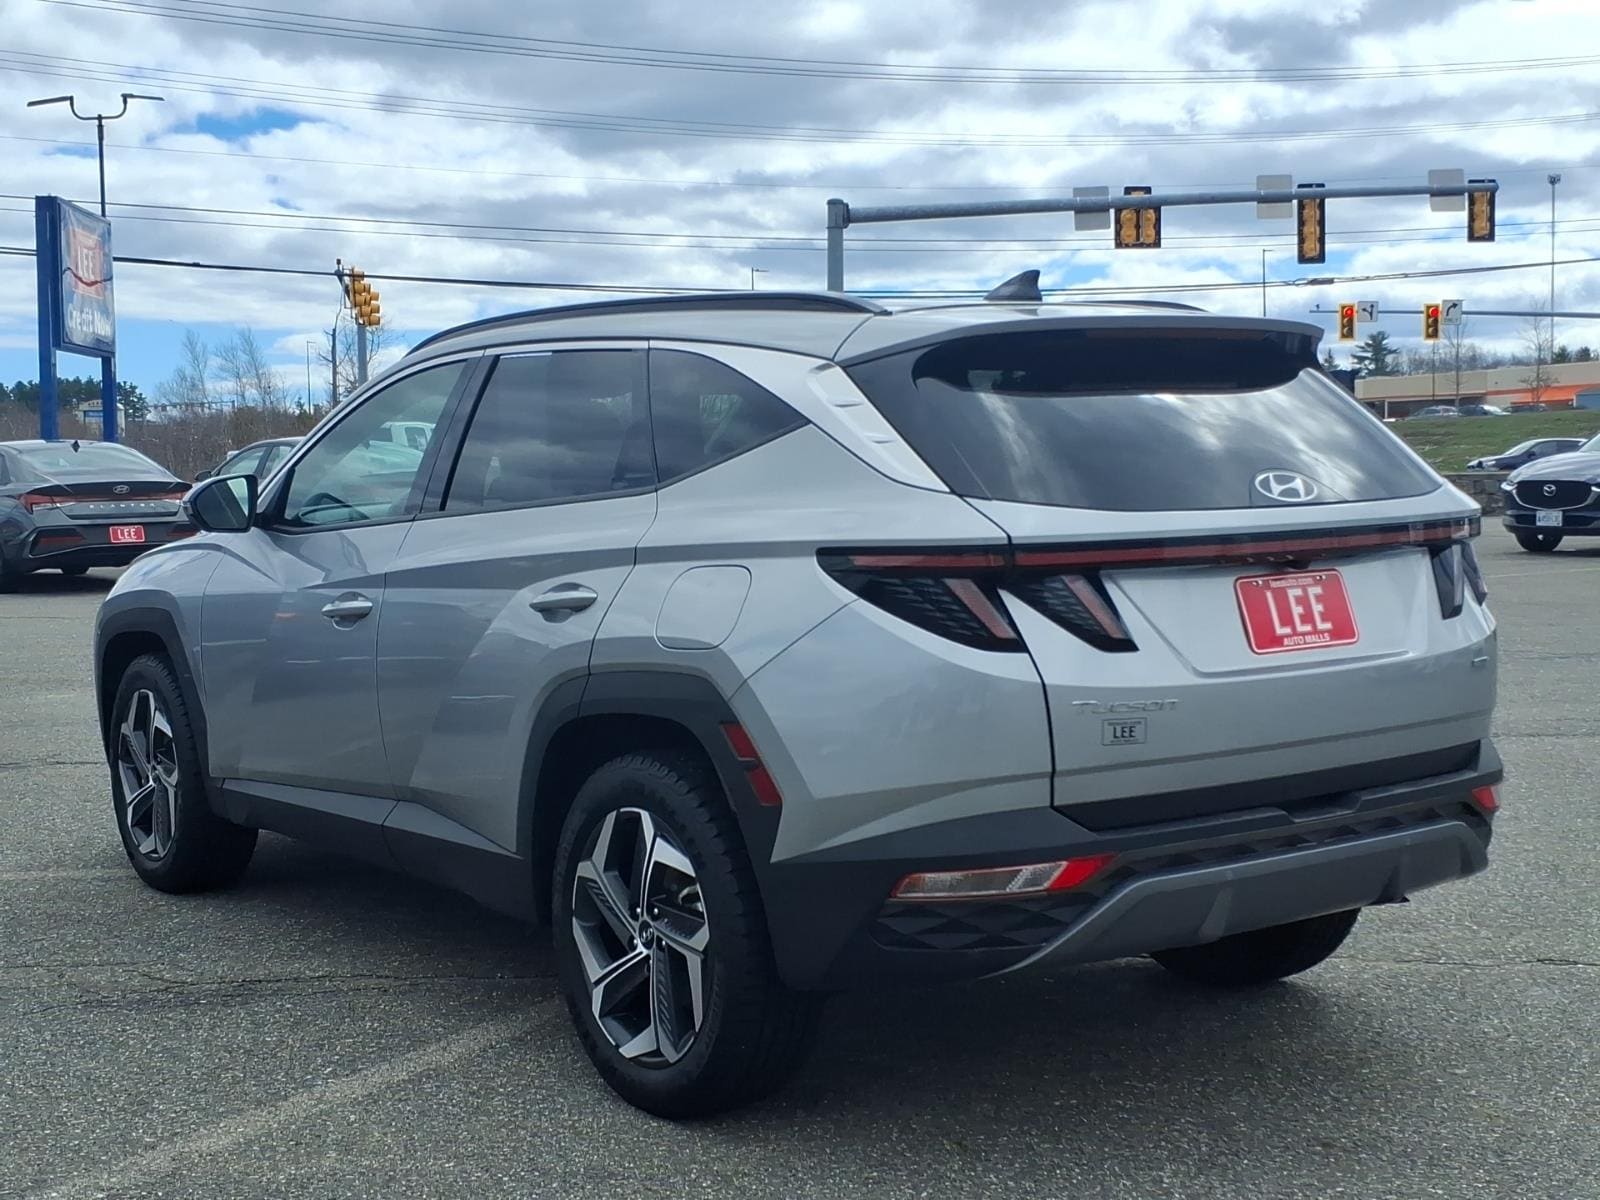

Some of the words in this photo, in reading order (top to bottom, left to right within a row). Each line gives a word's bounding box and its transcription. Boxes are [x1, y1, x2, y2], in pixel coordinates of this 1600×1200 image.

[78, 246, 95, 281] LEE
[68, 304, 92, 333] Credit
[94, 311, 112, 337] Now
[117, 528, 137, 539] LEE
[1265, 586, 1333, 635] LEE
[1283, 636, 1304, 646] AUTO
[1305, 633, 1330, 643] MALLS
[1113, 726, 1136, 739] LEE
